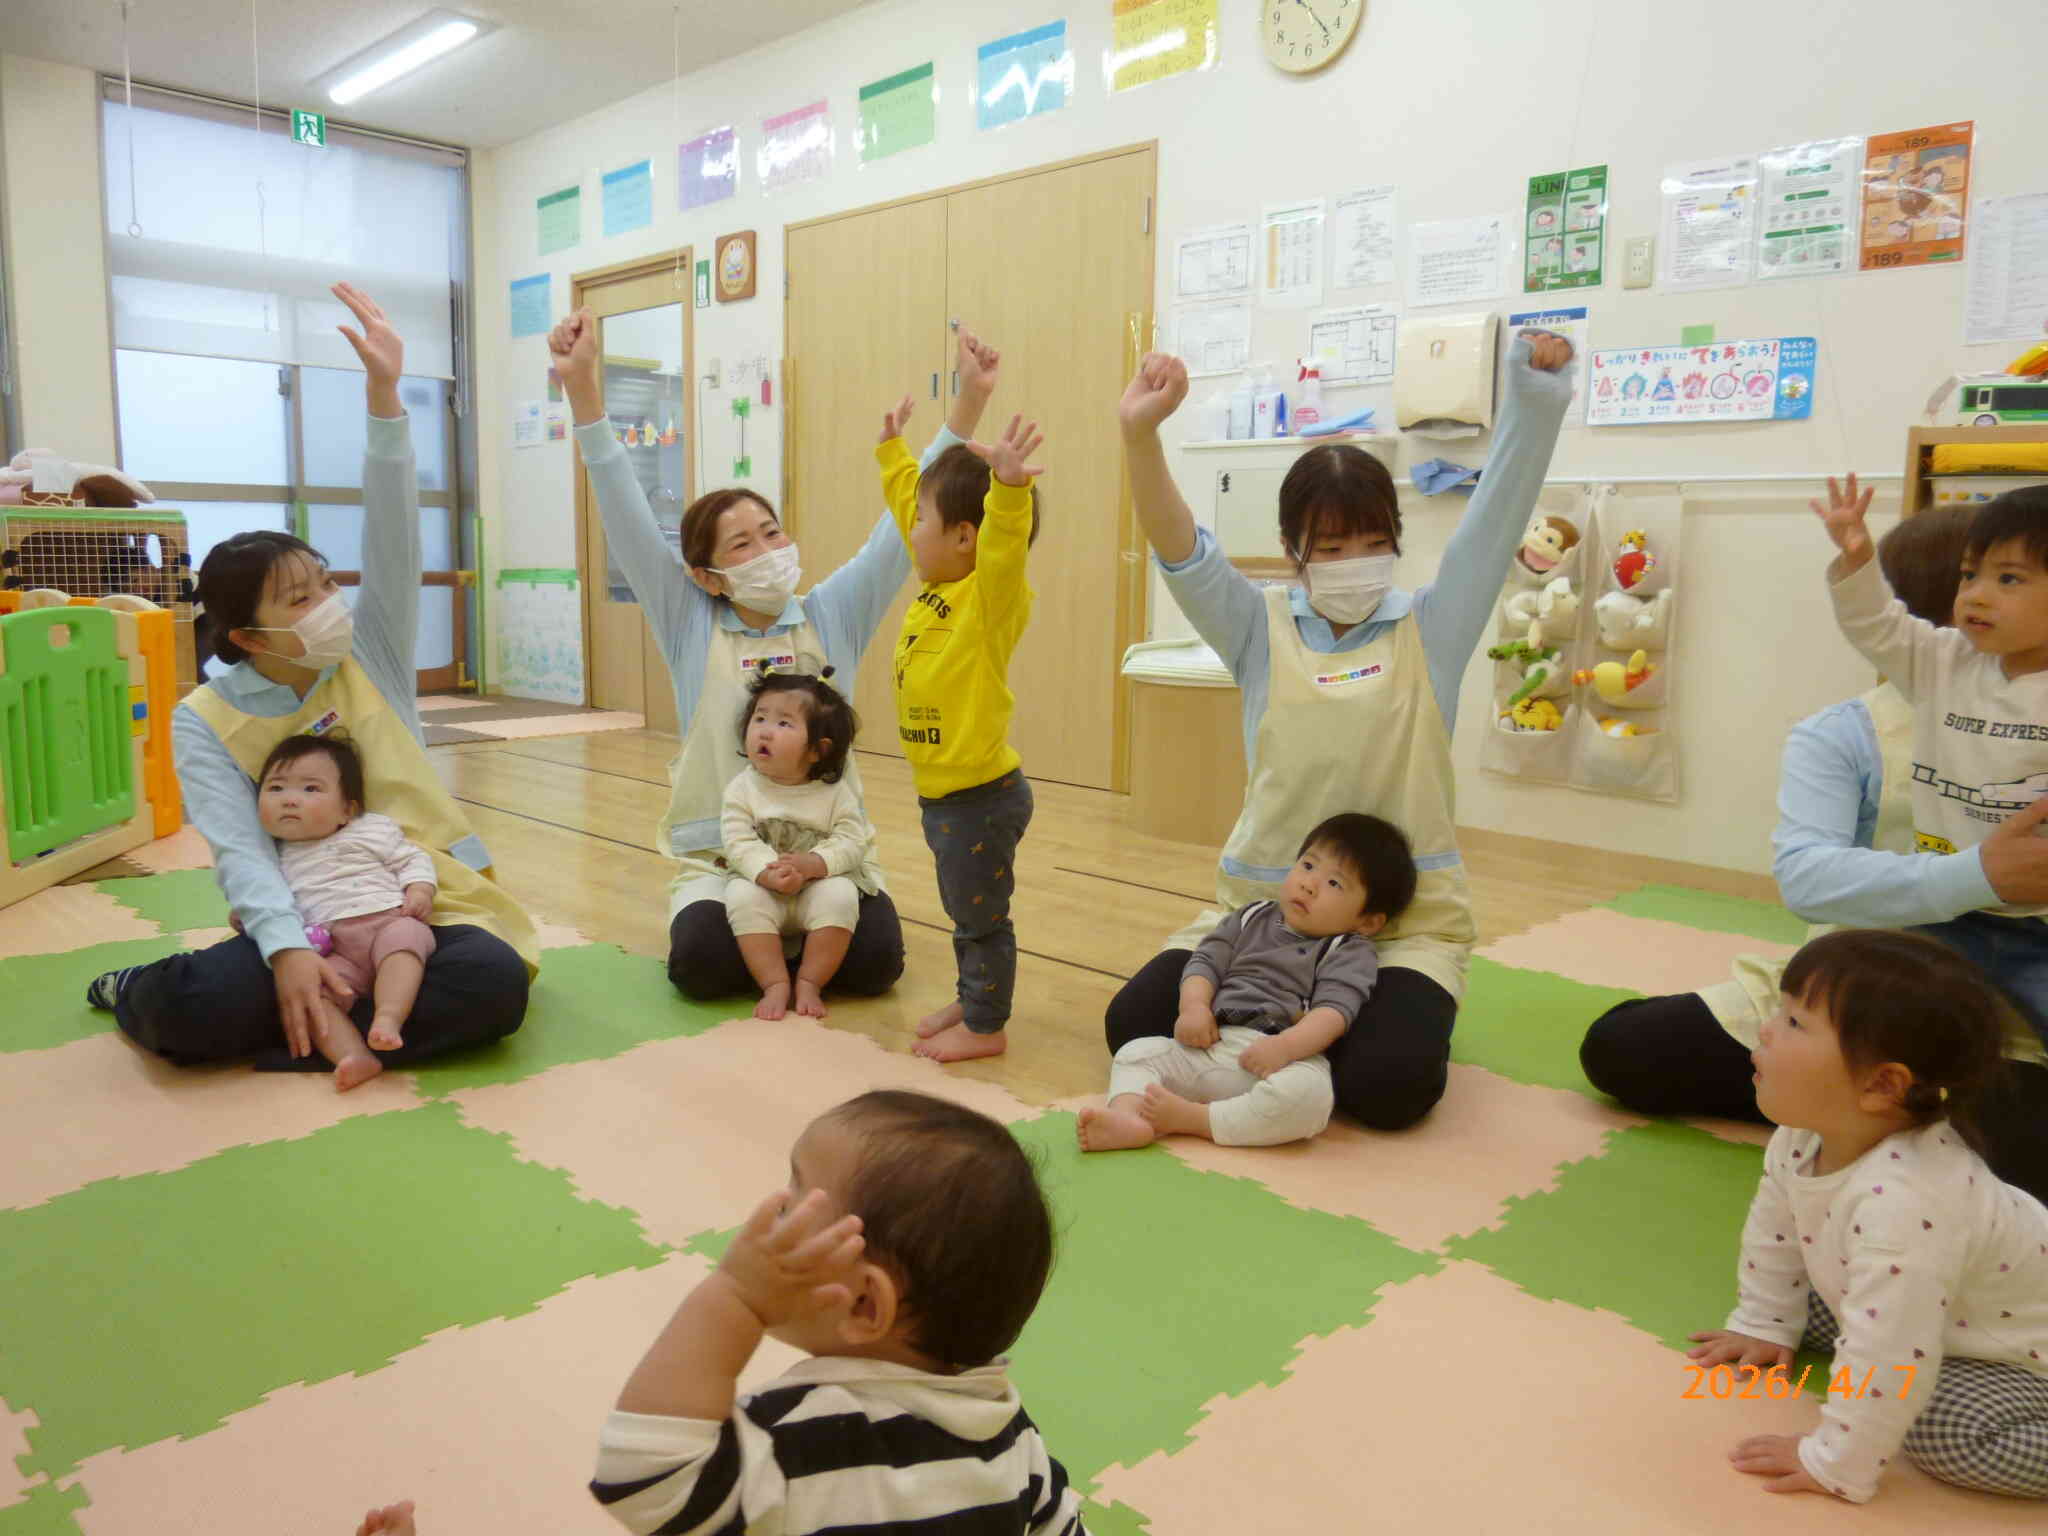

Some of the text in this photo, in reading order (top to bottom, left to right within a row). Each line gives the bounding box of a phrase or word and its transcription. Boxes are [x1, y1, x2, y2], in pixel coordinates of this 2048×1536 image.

[1334, 15, 1341, 29] 4
[1288, 42, 1296, 56] 7
[1304, 43, 1312, 56] 6
[1904, 136, 1929, 150] 189
[1872, 252, 1903, 266] 189
